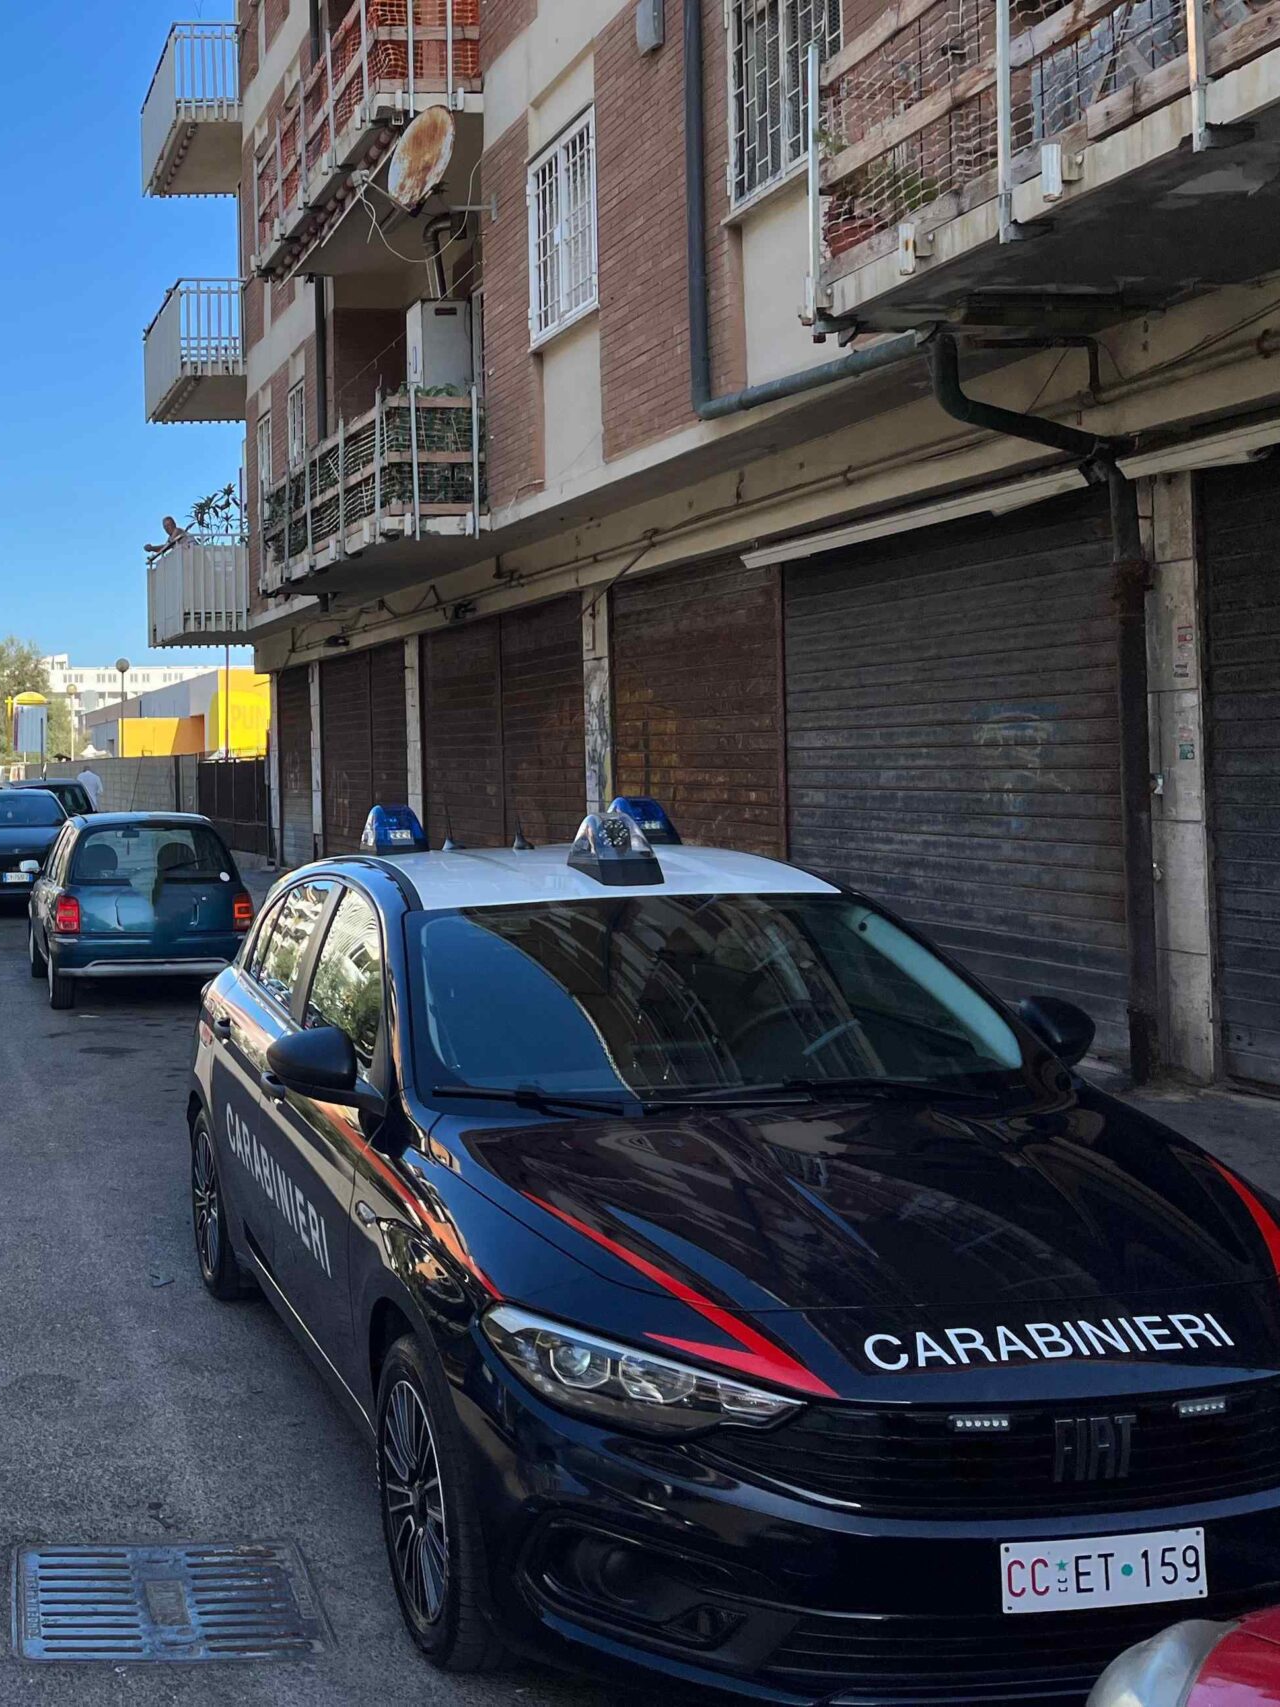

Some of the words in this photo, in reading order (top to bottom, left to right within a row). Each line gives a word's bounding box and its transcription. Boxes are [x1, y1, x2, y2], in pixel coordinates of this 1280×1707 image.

[226, 1102, 332, 1279] CARABINIERI
[863, 1313, 1235, 1371] CARABINIERI
[1053, 1414, 1137, 1482] FIAT
[1007, 1558, 1050, 1597] CC
[1074, 1552, 1115, 1593] ET
[1141, 1544, 1201, 1588] 159
